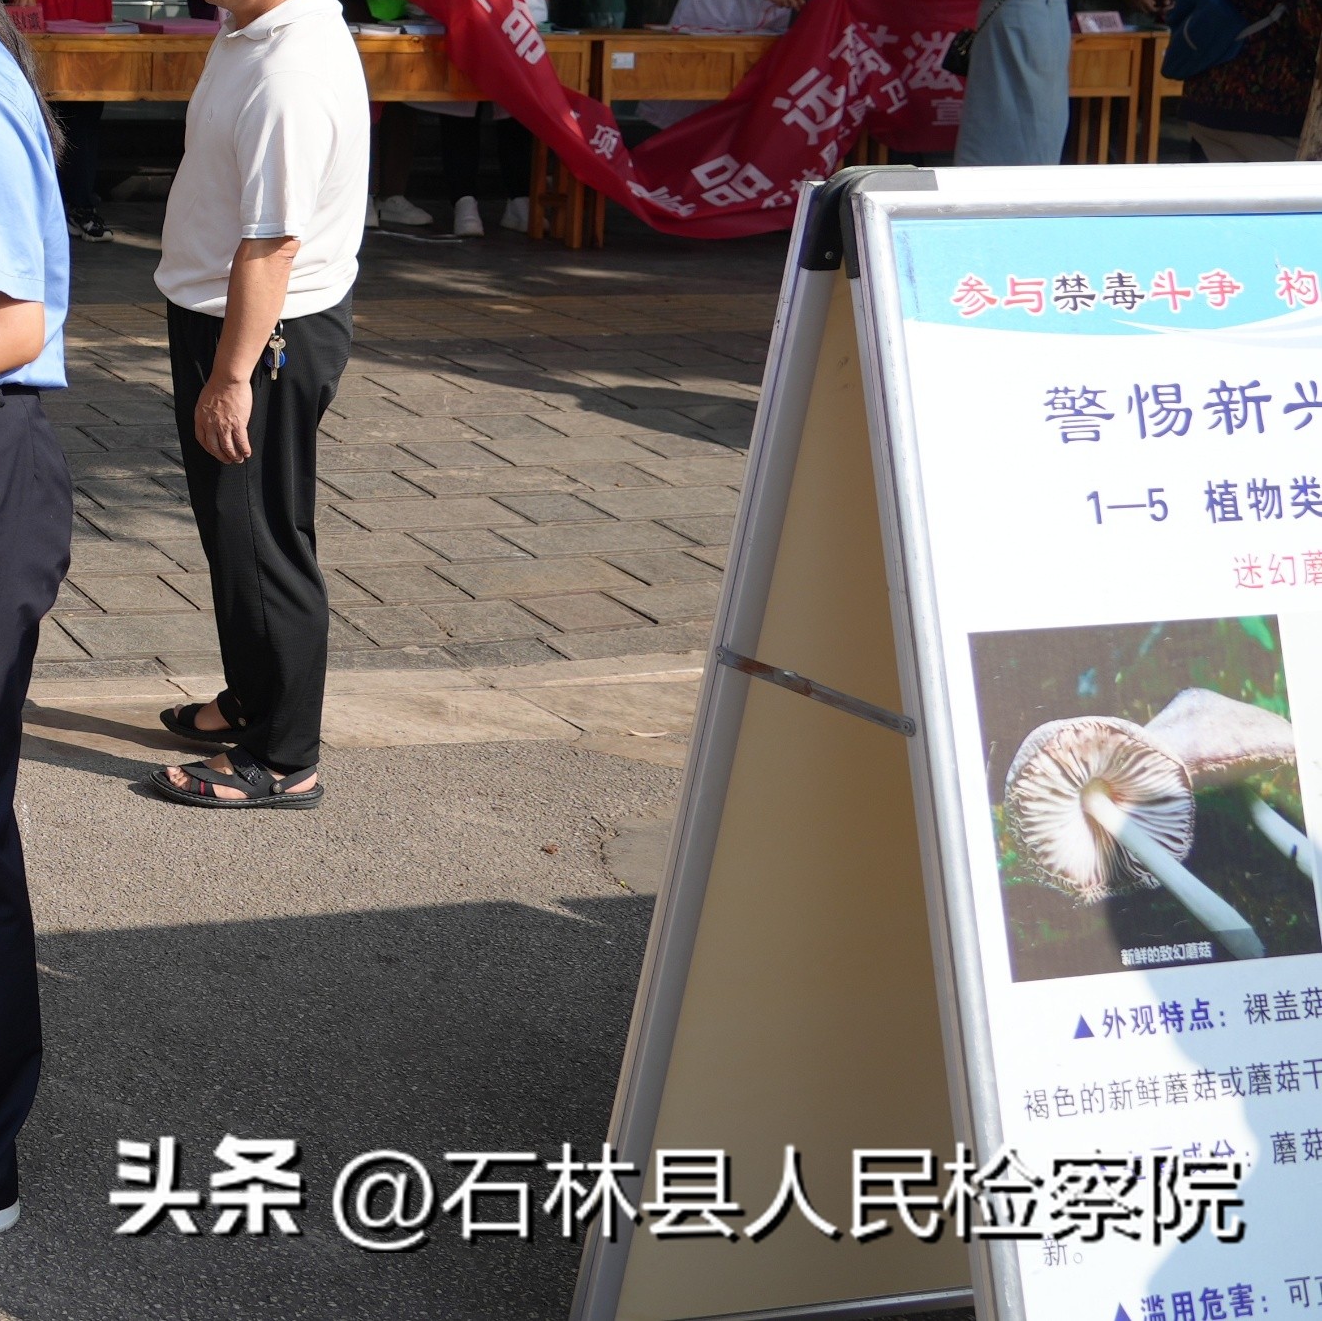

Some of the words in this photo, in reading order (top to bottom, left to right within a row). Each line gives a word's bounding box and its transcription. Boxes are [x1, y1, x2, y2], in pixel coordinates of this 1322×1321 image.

[950, 273, 1244, 318] 参与禁毒斗争
[1205, 476, 1322, 524] 植物类
[1120, 941, 1213, 967] 新鲜的致幻蘑菇
[1140, 1276, 1322, 1321] 滥用危害：可
